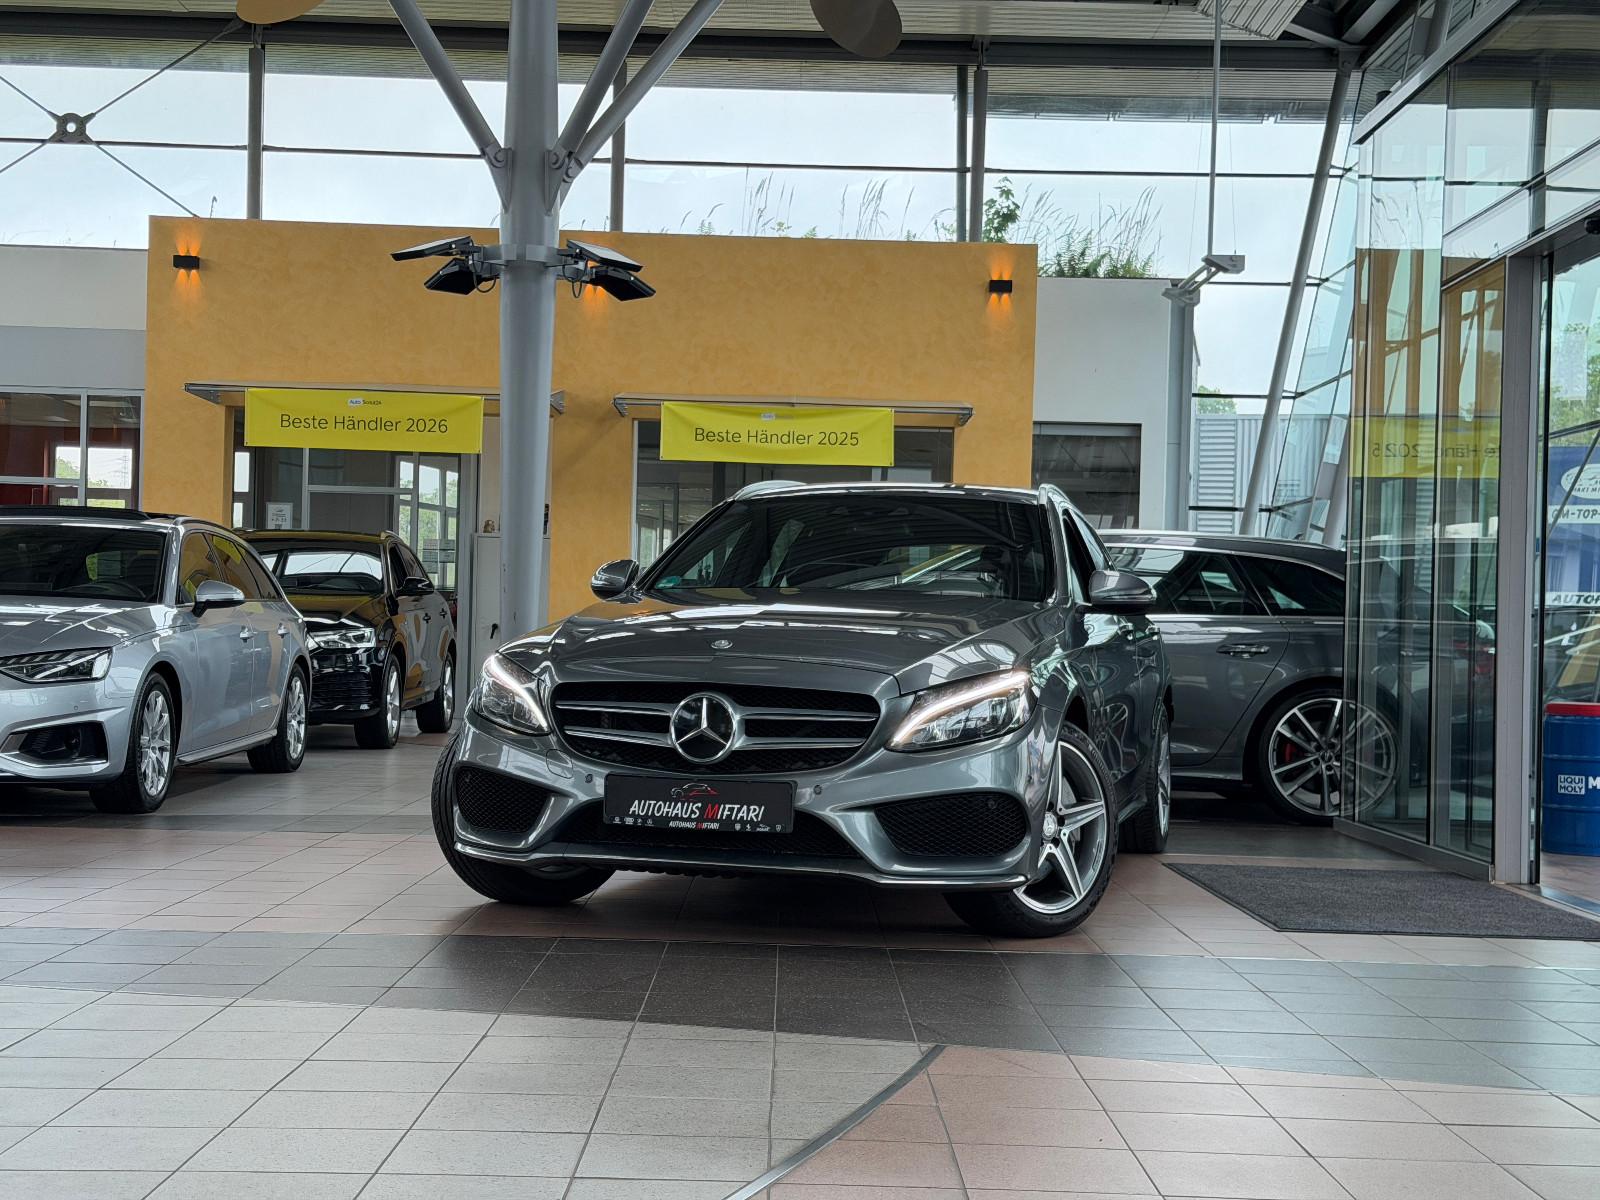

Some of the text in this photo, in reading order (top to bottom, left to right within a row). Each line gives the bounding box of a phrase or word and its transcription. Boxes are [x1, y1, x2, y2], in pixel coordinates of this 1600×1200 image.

[280, 413, 448, 434] Beste Händler 2026
[694, 427, 859, 447] Beste Händler 2025
[1559, 776, 1584, 785] LIQUI
[1559, 785, 1584, 794] MOLY
[629, 800, 765, 822] AUTOHAUS MIFTARI
[668, 820, 720, 831] AUTOHAUS MIFTARI
